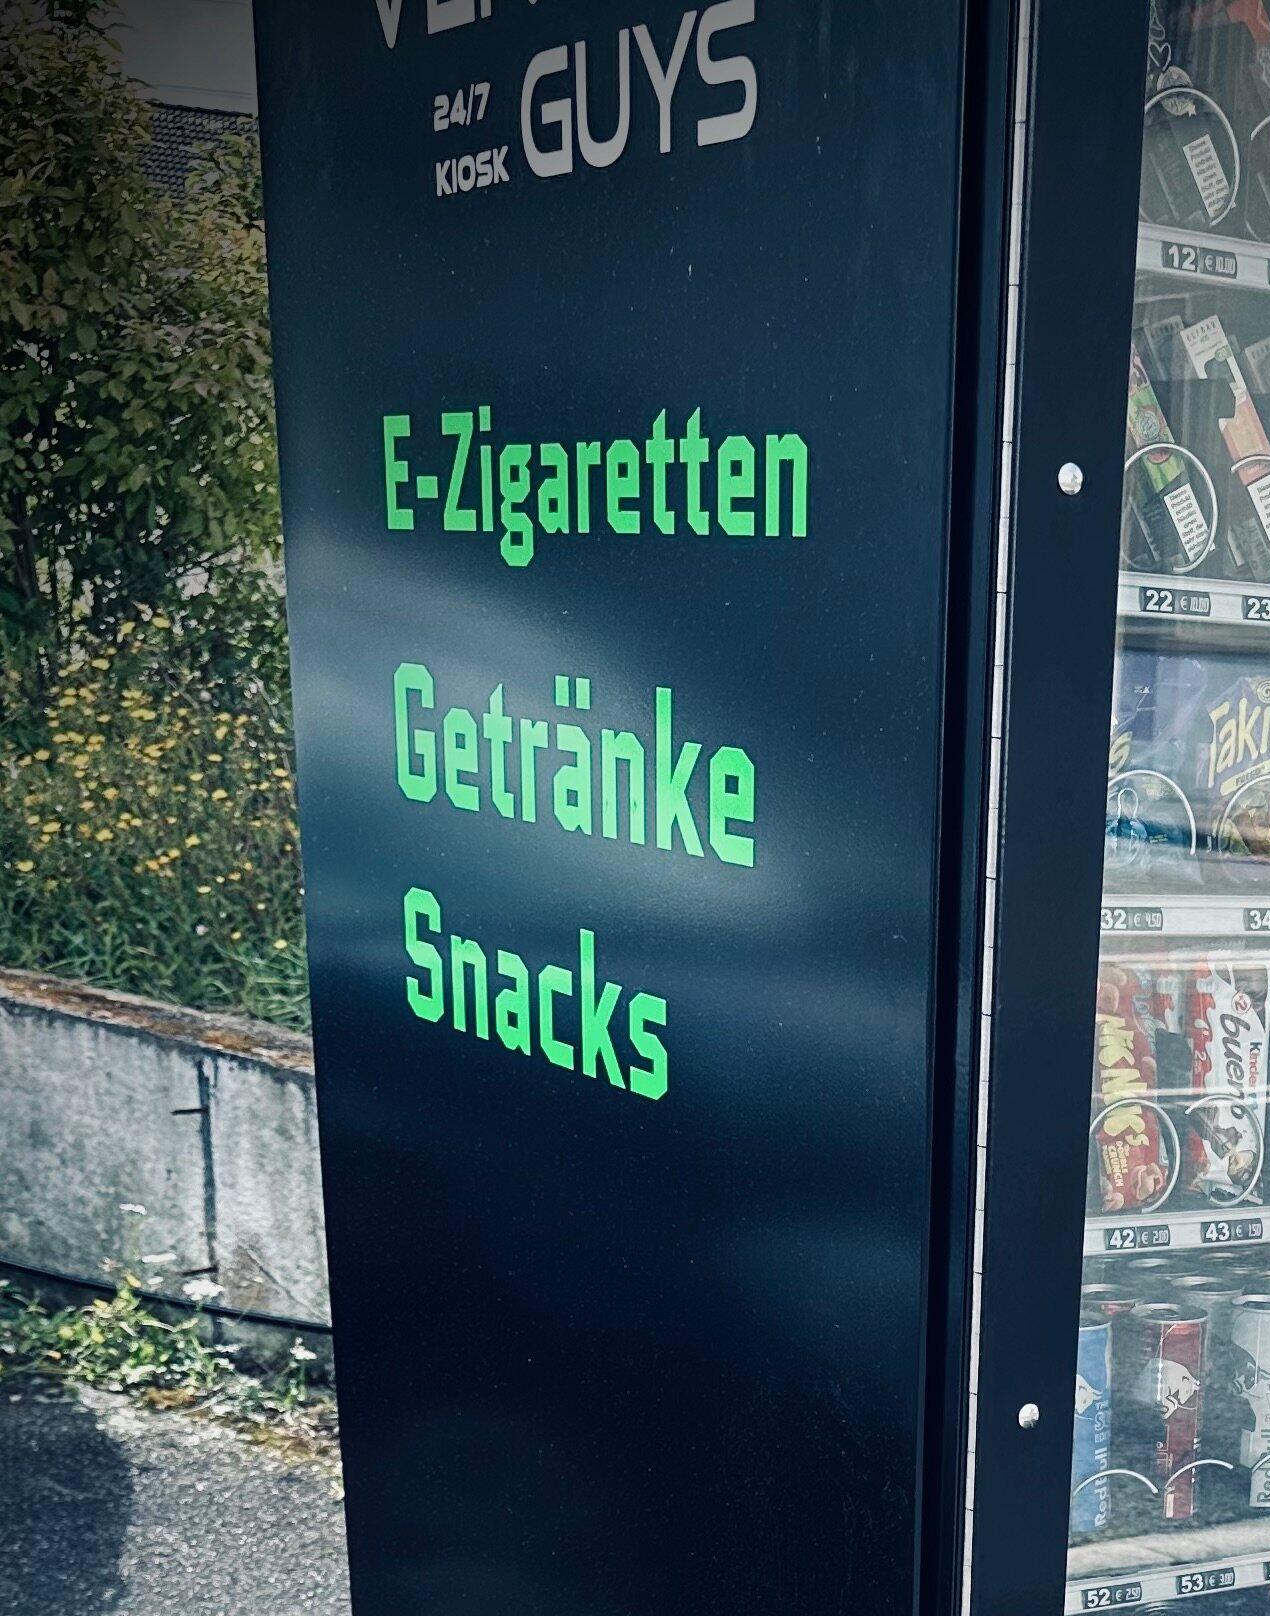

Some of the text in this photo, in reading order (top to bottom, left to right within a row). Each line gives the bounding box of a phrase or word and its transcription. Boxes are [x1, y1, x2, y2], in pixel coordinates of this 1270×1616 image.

[520, 0, 758, 178] GUYS
[432, 82, 491, 132] 24/7
[435, 145, 510, 197] KIOSK
[1169, 244, 1197, 272] 12
[383, 405, 808, 567] E-Zigaretten
[1146, 590, 1173, 611] 22
[394, 661, 755, 868] Getränke
[1101, 909, 1127, 929] 32
[404, 886, 668, 1101] Snacks
[1109, 1229, 1135, 1248] 42
[1205, 1222, 1230, 1241] 43
[1181, 1574, 1203, 1593] 53
[1087, 1589, 1111, 1608] 52
